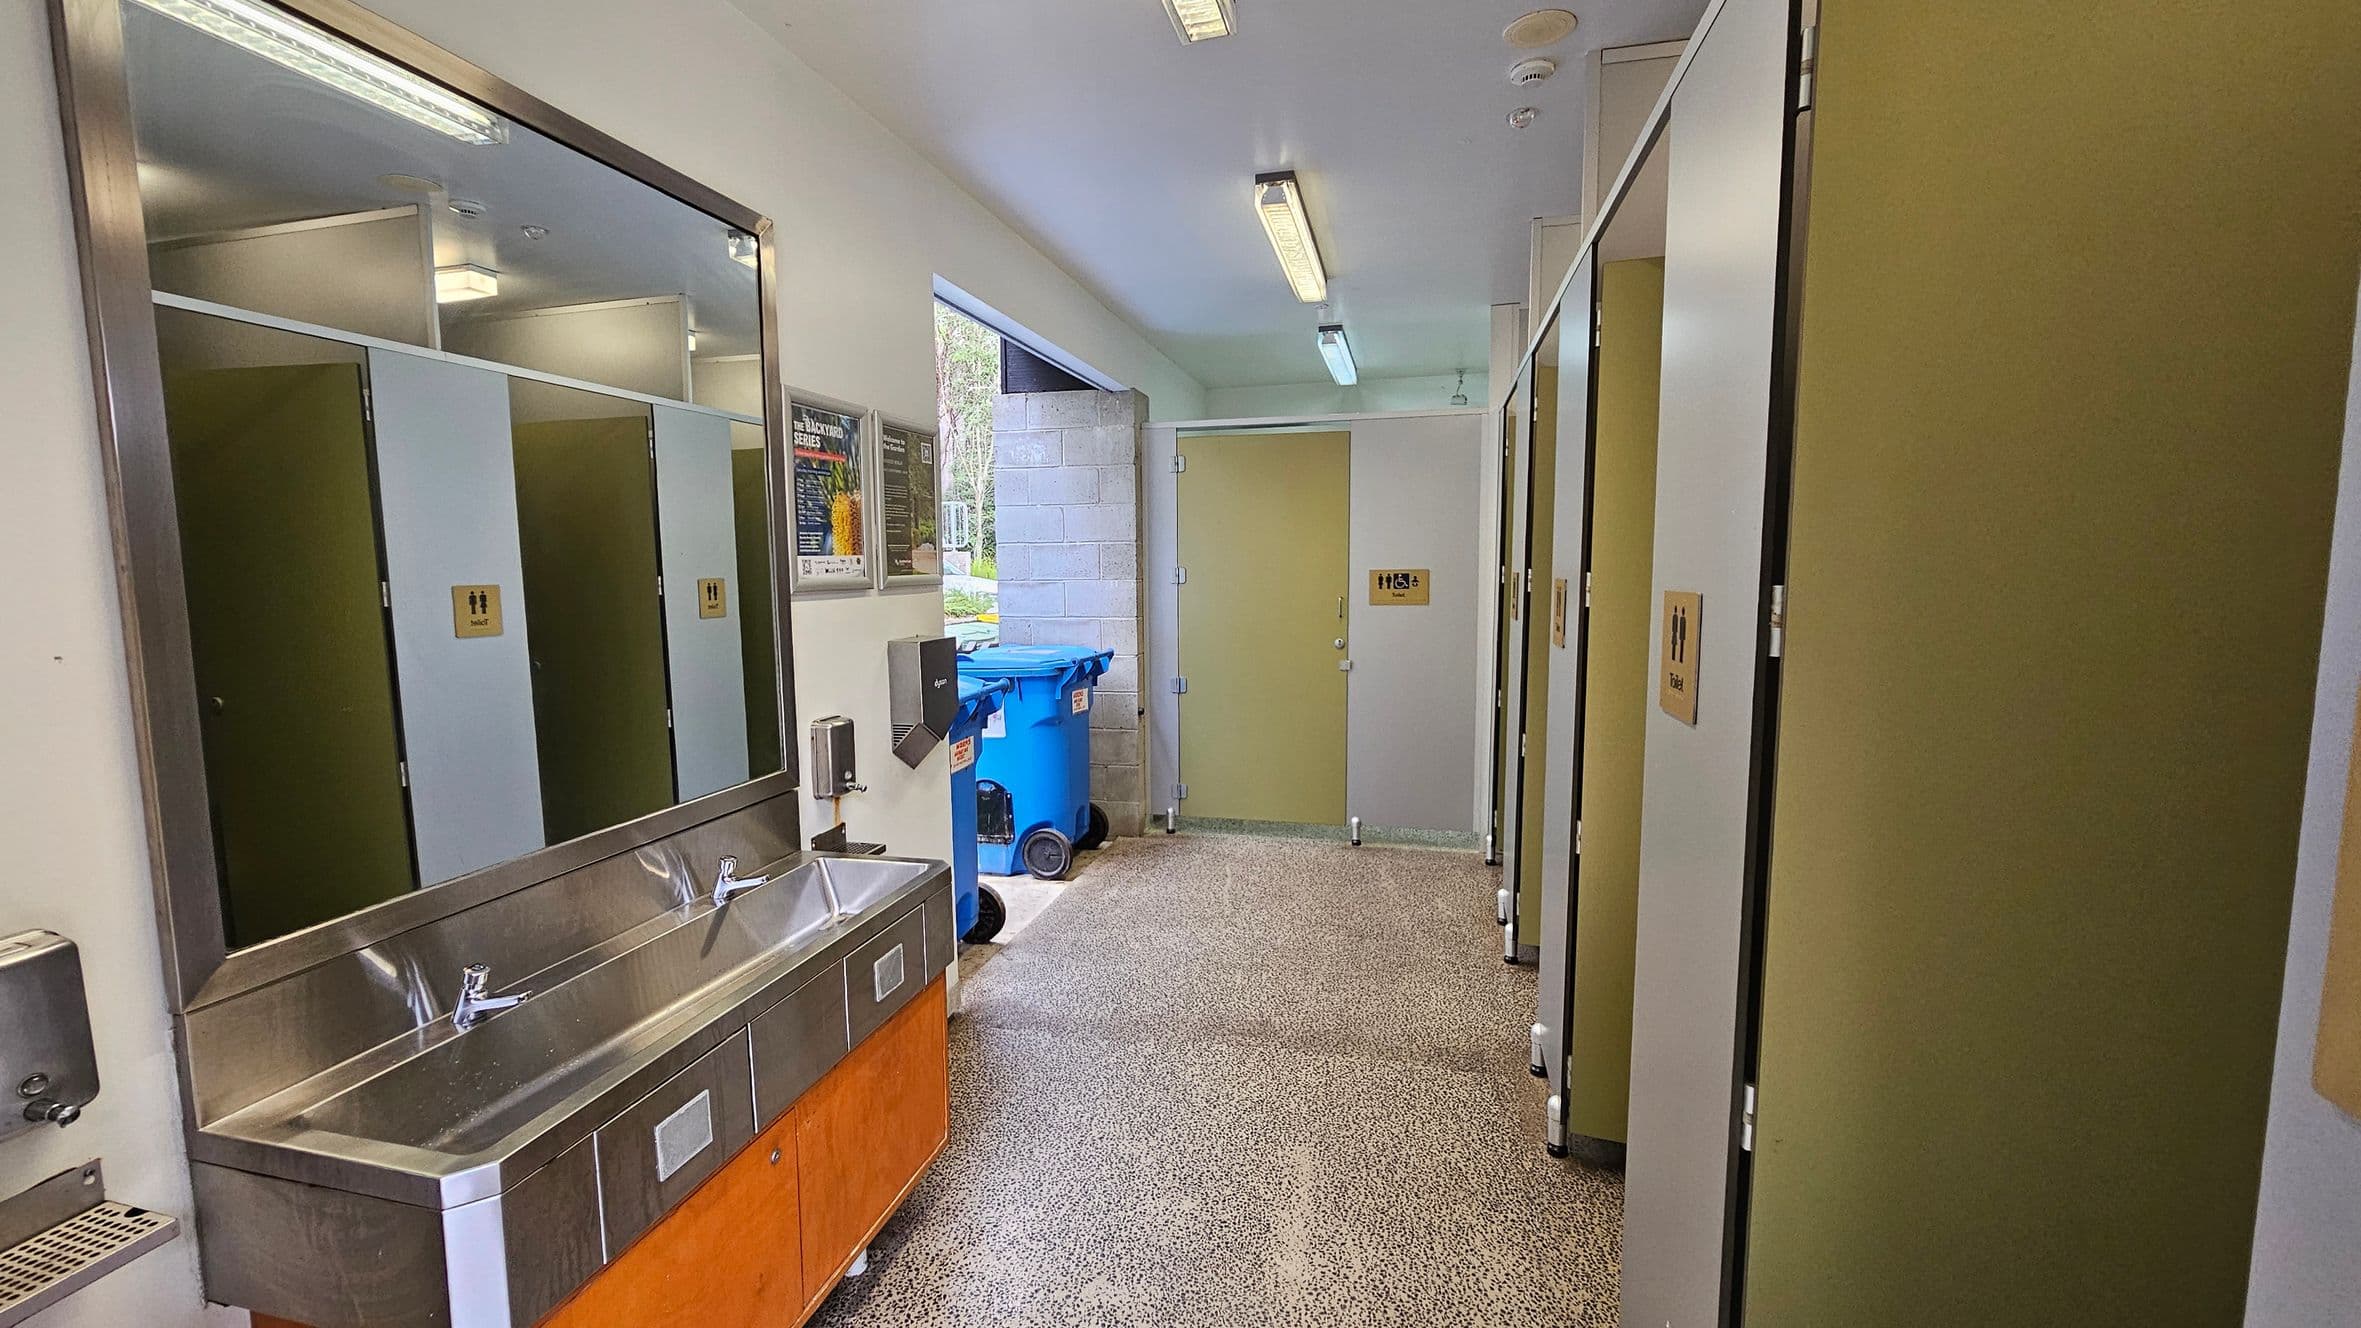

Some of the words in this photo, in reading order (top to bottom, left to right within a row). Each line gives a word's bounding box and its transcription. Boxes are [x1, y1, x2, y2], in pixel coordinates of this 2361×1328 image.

[793, 420, 805, 432] THE
[805, 419, 843, 438] BACKYARD
[793, 431, 821, 448] SERIES
[934, 678, 948, 689] dyson
[1670, 672, 1684, 692] Toilet
